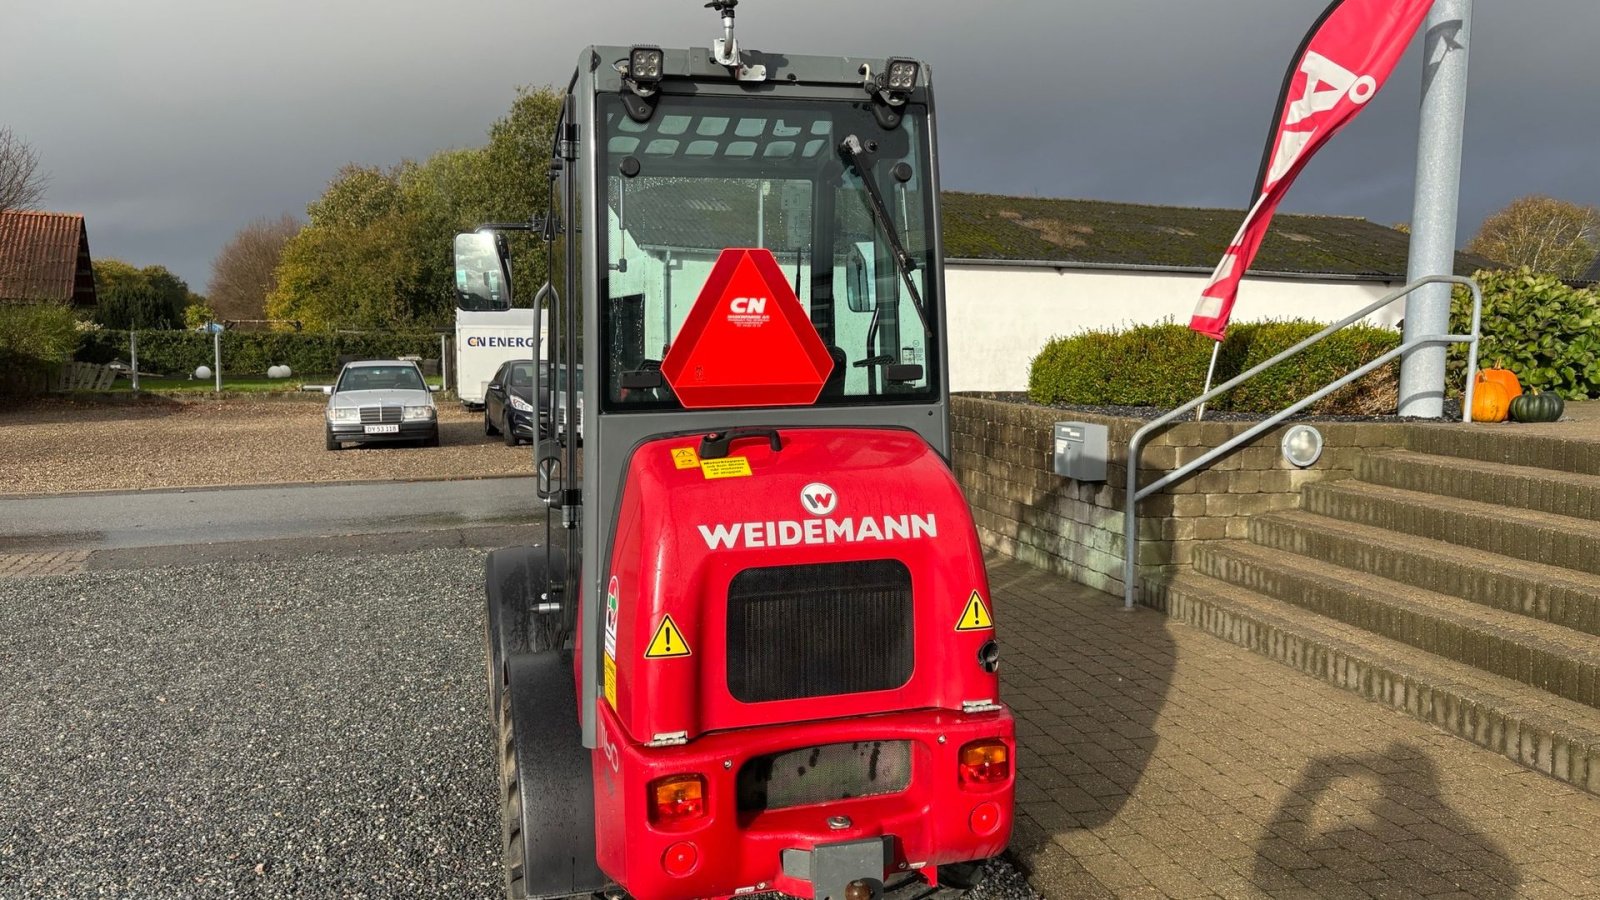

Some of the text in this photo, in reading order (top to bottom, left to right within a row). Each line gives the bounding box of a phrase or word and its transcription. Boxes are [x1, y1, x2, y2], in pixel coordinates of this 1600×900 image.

[730, 297, 767, 314] CN
[467, 336, 486, 347] CN
[804, 493, 832, 508] W
[697, 513, 938, 550] WEIDEMANN
